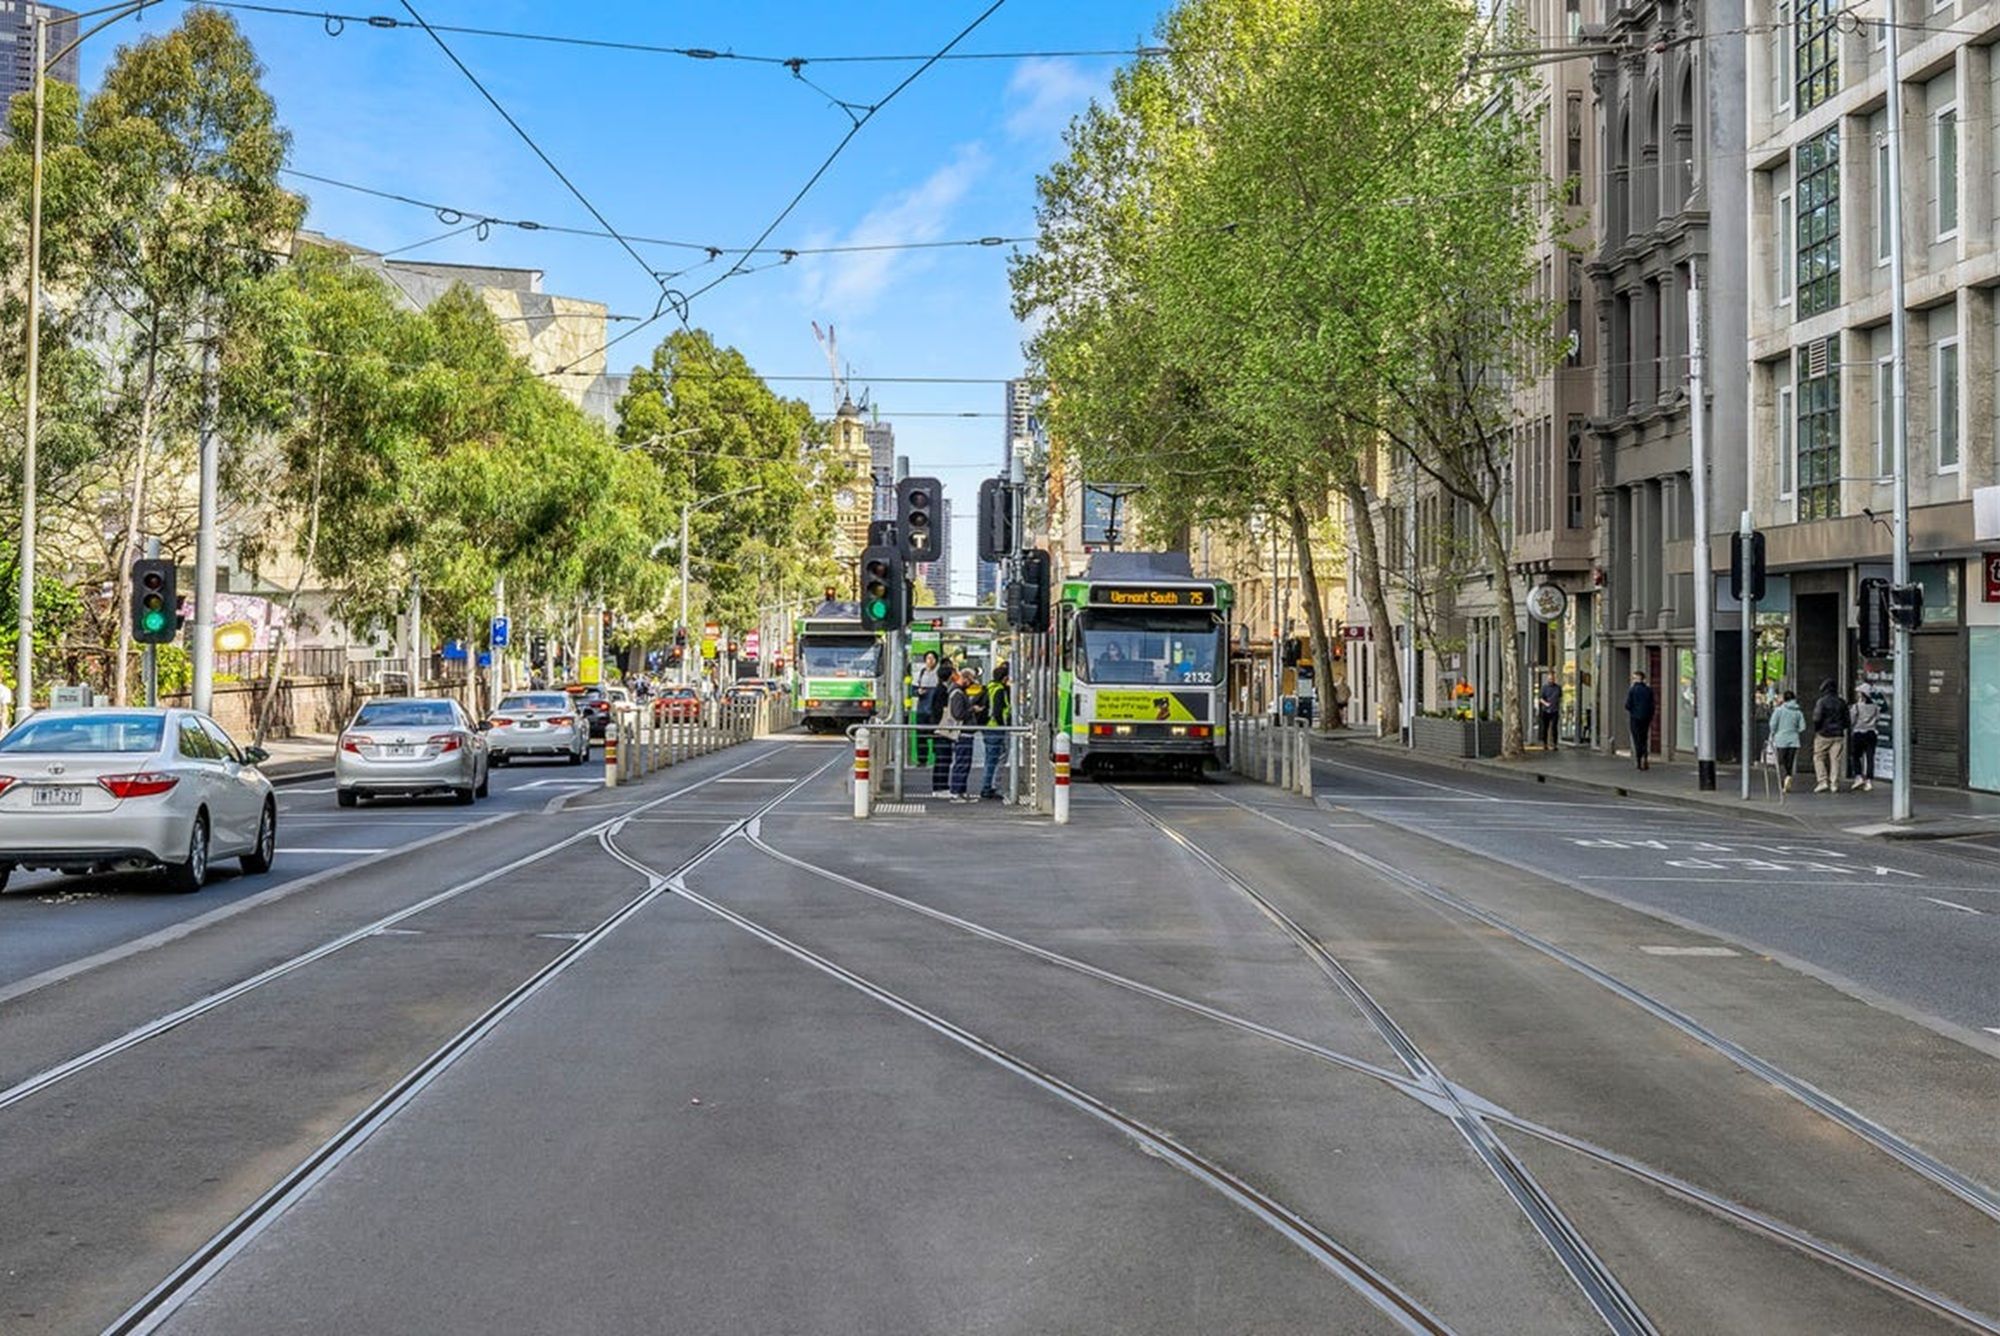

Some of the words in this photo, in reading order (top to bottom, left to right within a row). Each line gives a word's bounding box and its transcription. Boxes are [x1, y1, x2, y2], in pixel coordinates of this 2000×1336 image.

[1110, 590, 1149, 603] Vermont
[1150, 590, 1178, 603] South
[1190, 591, 1204, 604] 75
[1183, 671, 1213, 684] 2132
[1563, 837, 1847, 858] CLEAR
[1664, 857, 1924, 878] KEEP
